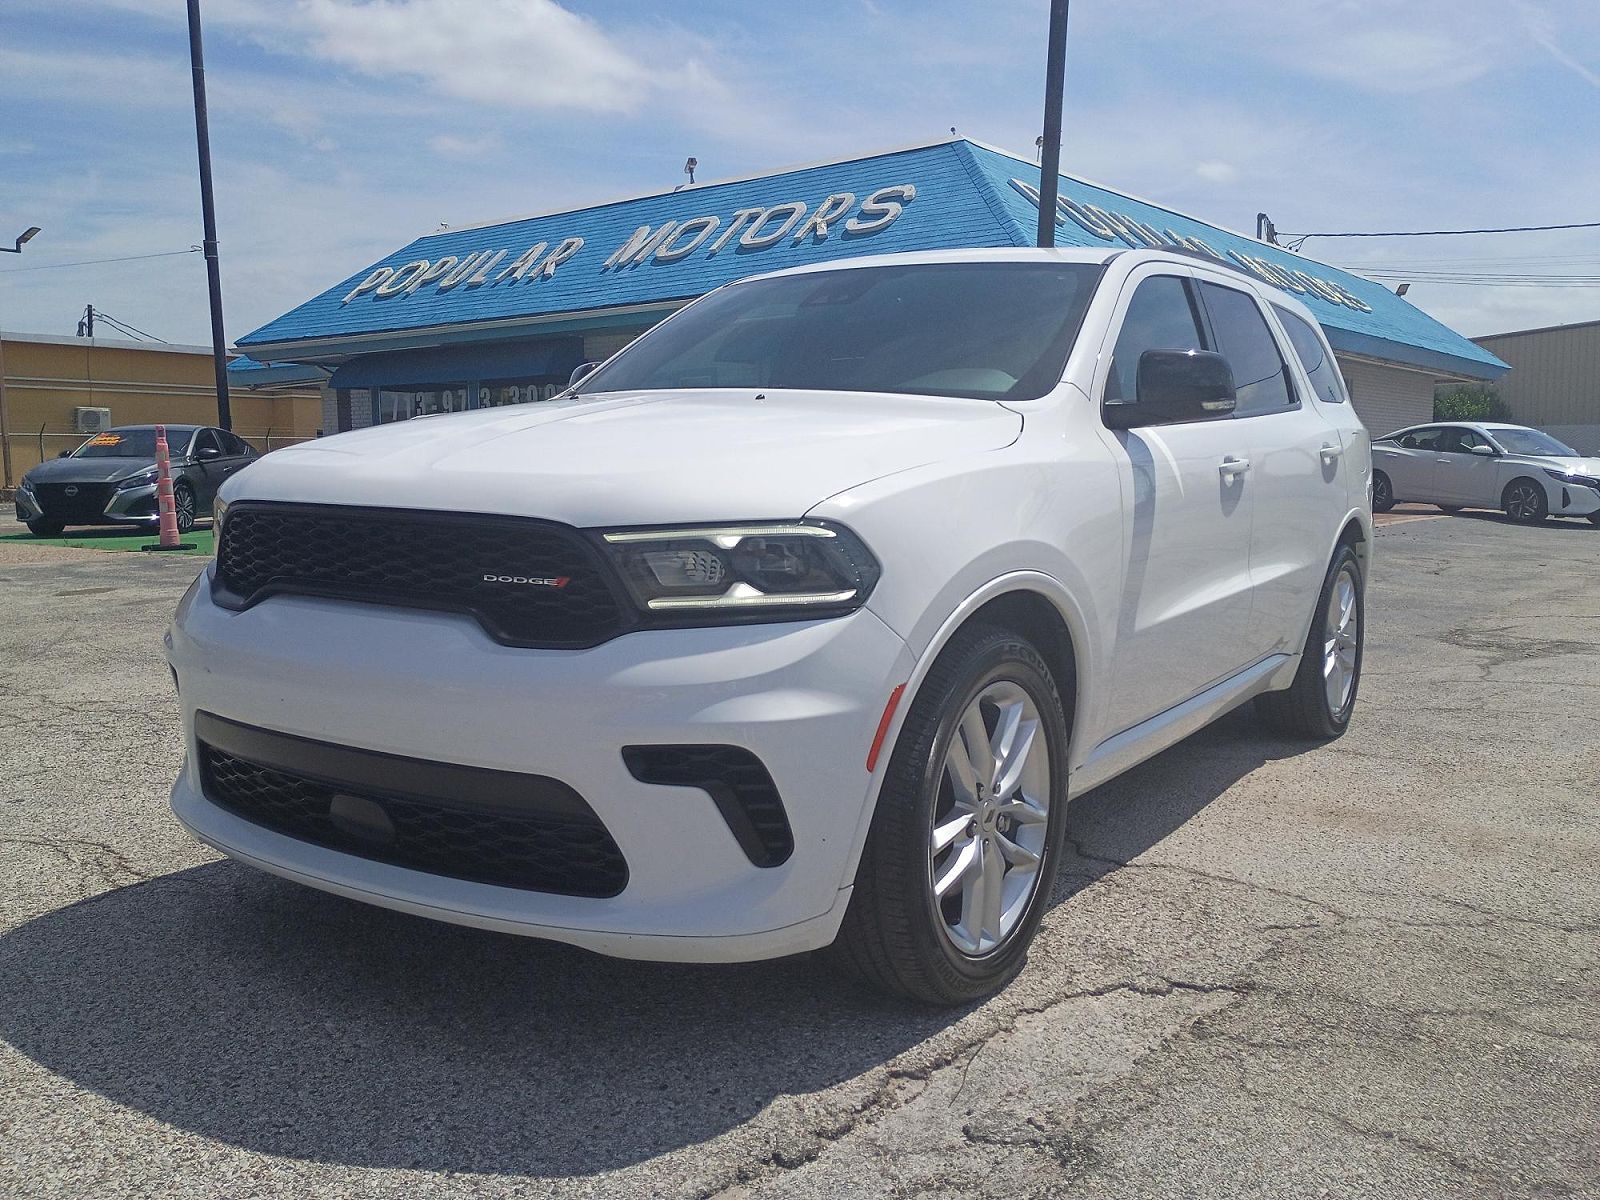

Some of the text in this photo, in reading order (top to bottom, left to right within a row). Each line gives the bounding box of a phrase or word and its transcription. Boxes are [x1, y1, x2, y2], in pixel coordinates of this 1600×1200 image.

[342, 184, 916, 305] POPULAR MOTORS
[483, 574, 559, 586] DODGE
